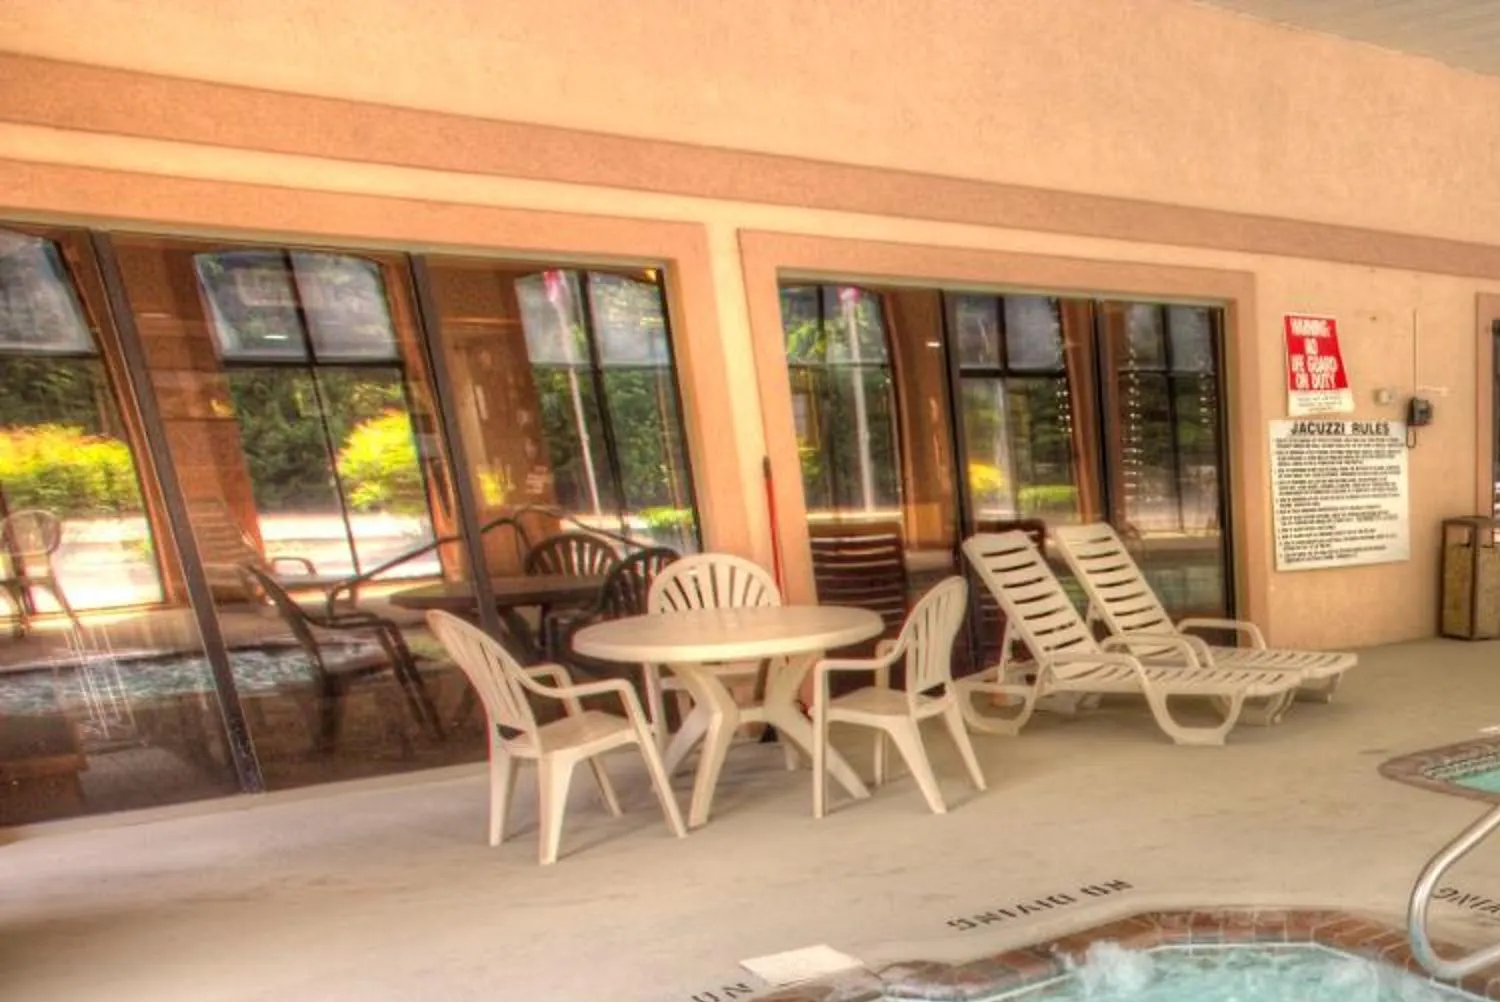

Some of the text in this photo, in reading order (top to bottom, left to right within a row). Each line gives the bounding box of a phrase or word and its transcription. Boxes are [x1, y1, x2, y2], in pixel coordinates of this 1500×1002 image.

[1296, 373, 1337, 390] ON DUTY
[1291, 422, 1390, 436] JACUZZI RULES
[947, 893, 1078, 931] DIVING
